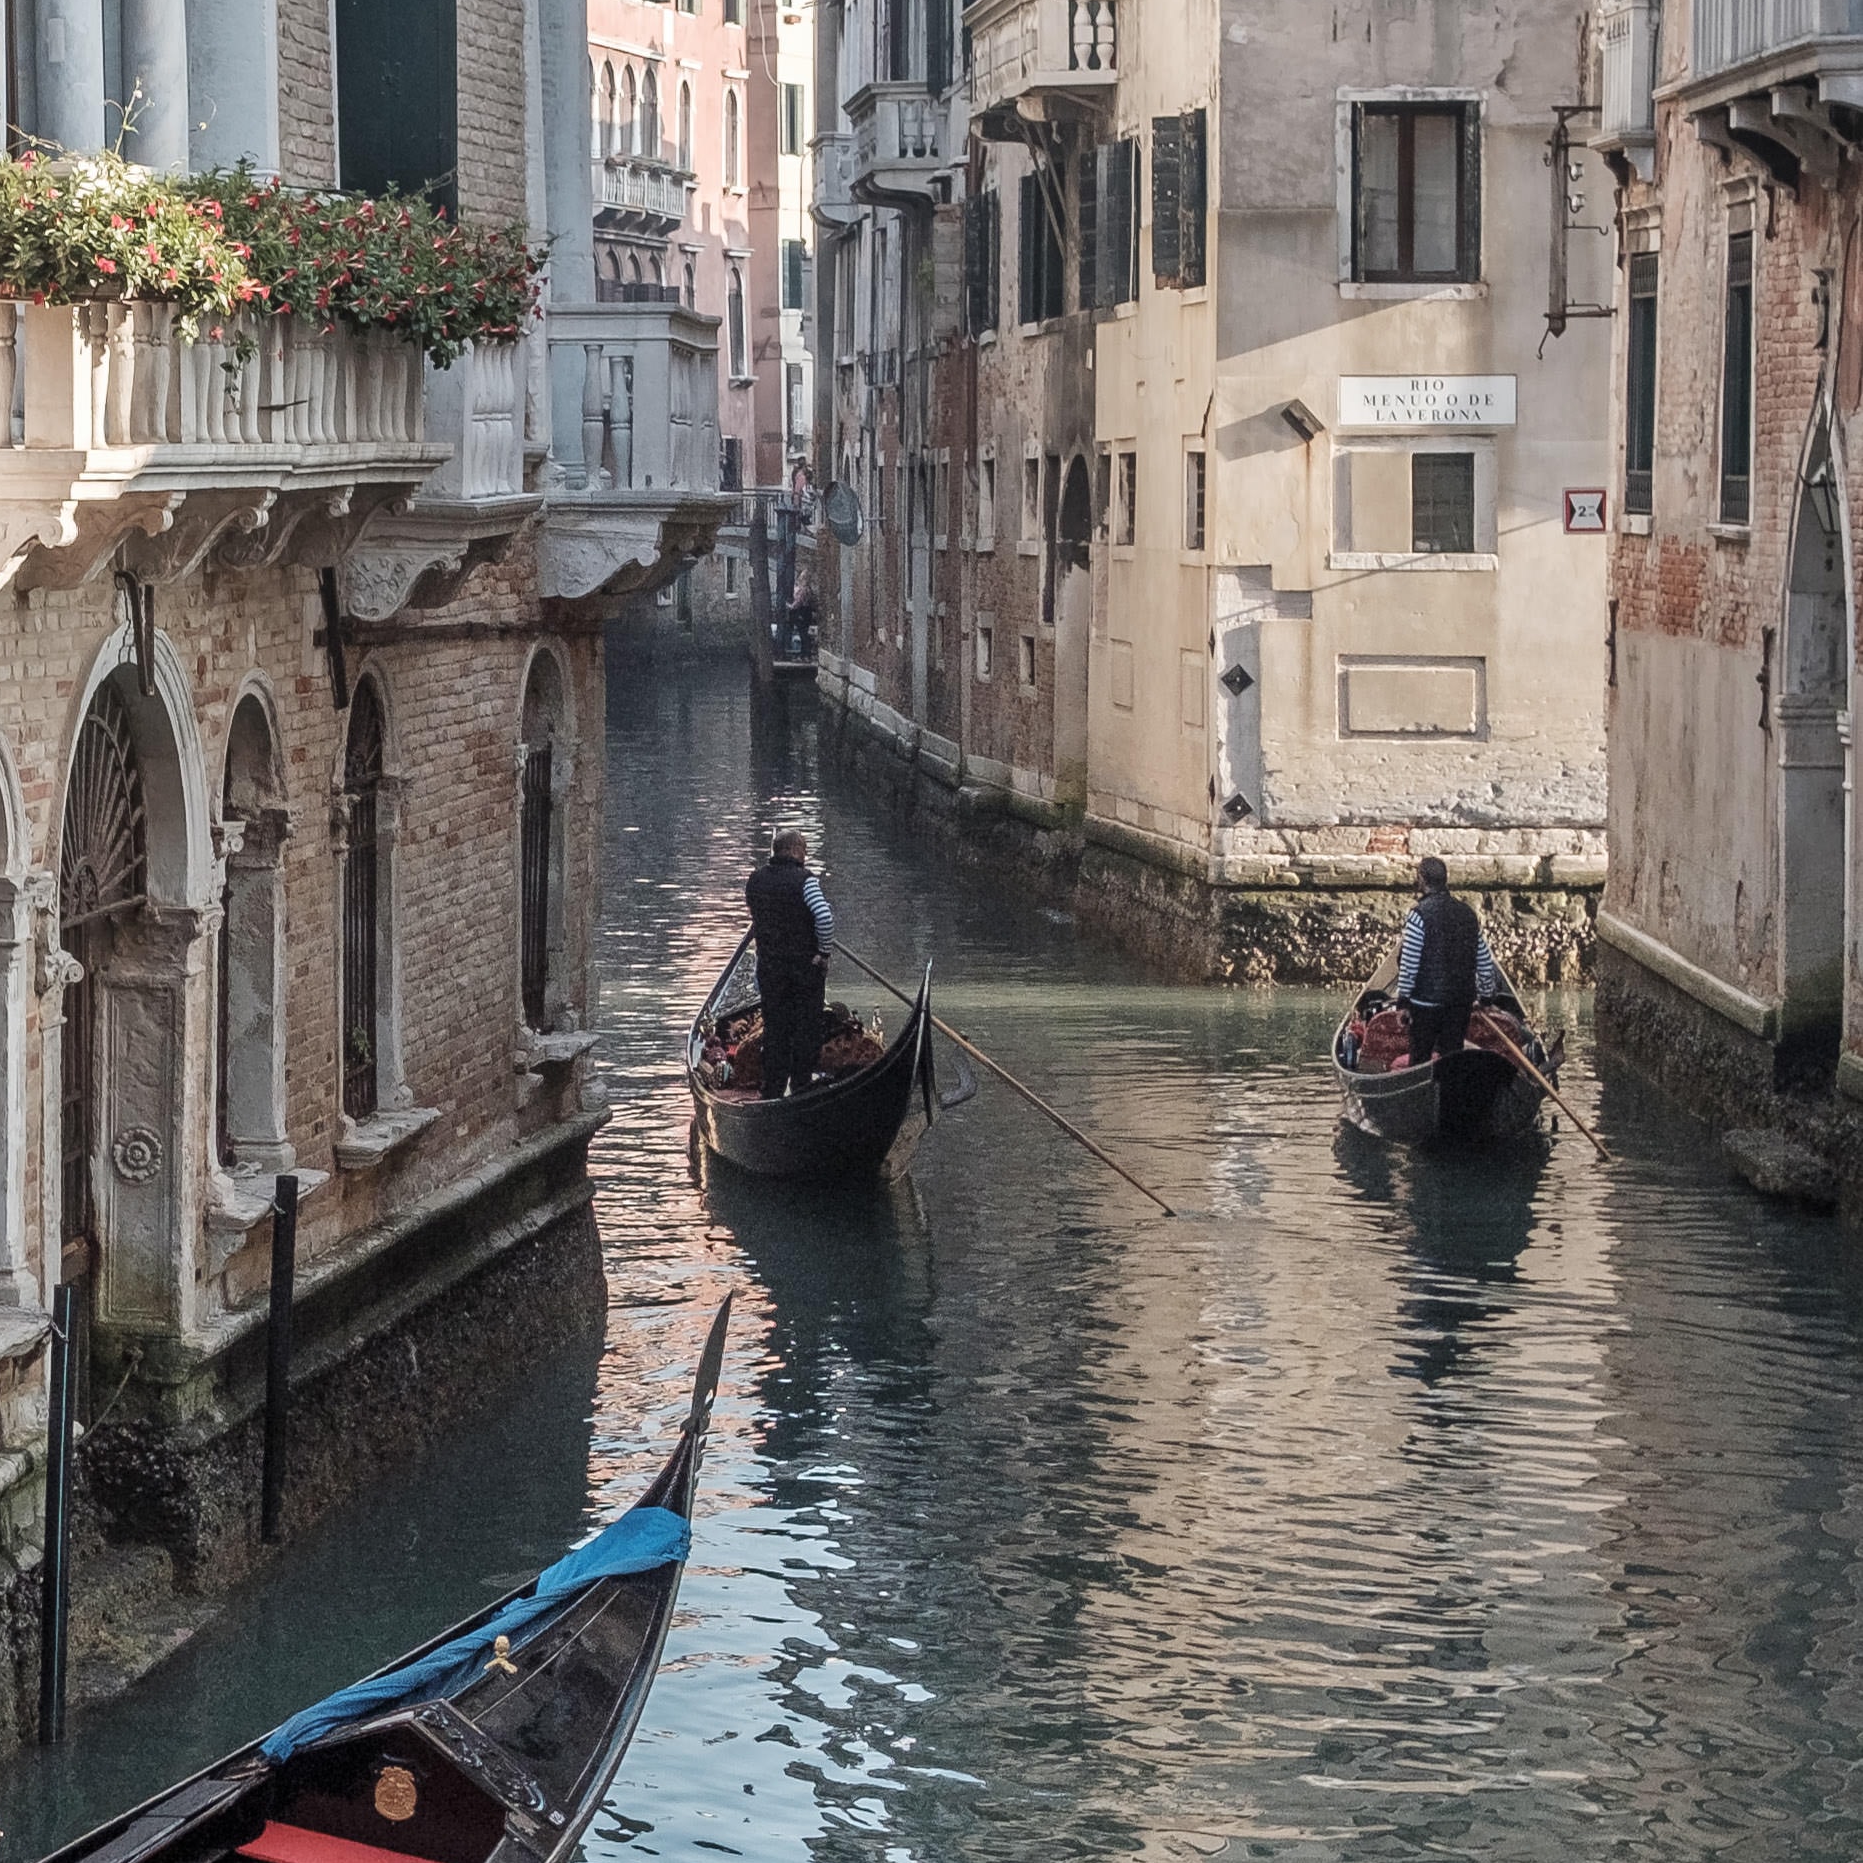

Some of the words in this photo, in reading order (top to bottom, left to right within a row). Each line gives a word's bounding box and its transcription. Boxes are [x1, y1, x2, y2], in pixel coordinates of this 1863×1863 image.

[1411, 379, 1444, 391] RIO
[1363, 394, 1436, 406] MENUO
[1446, 394, 1458, 406] O
[1469, 394, 1494, 406] DE
[1376, 409, 1397, 421] LA
[1406, 409, 1482, 421] VERONA
